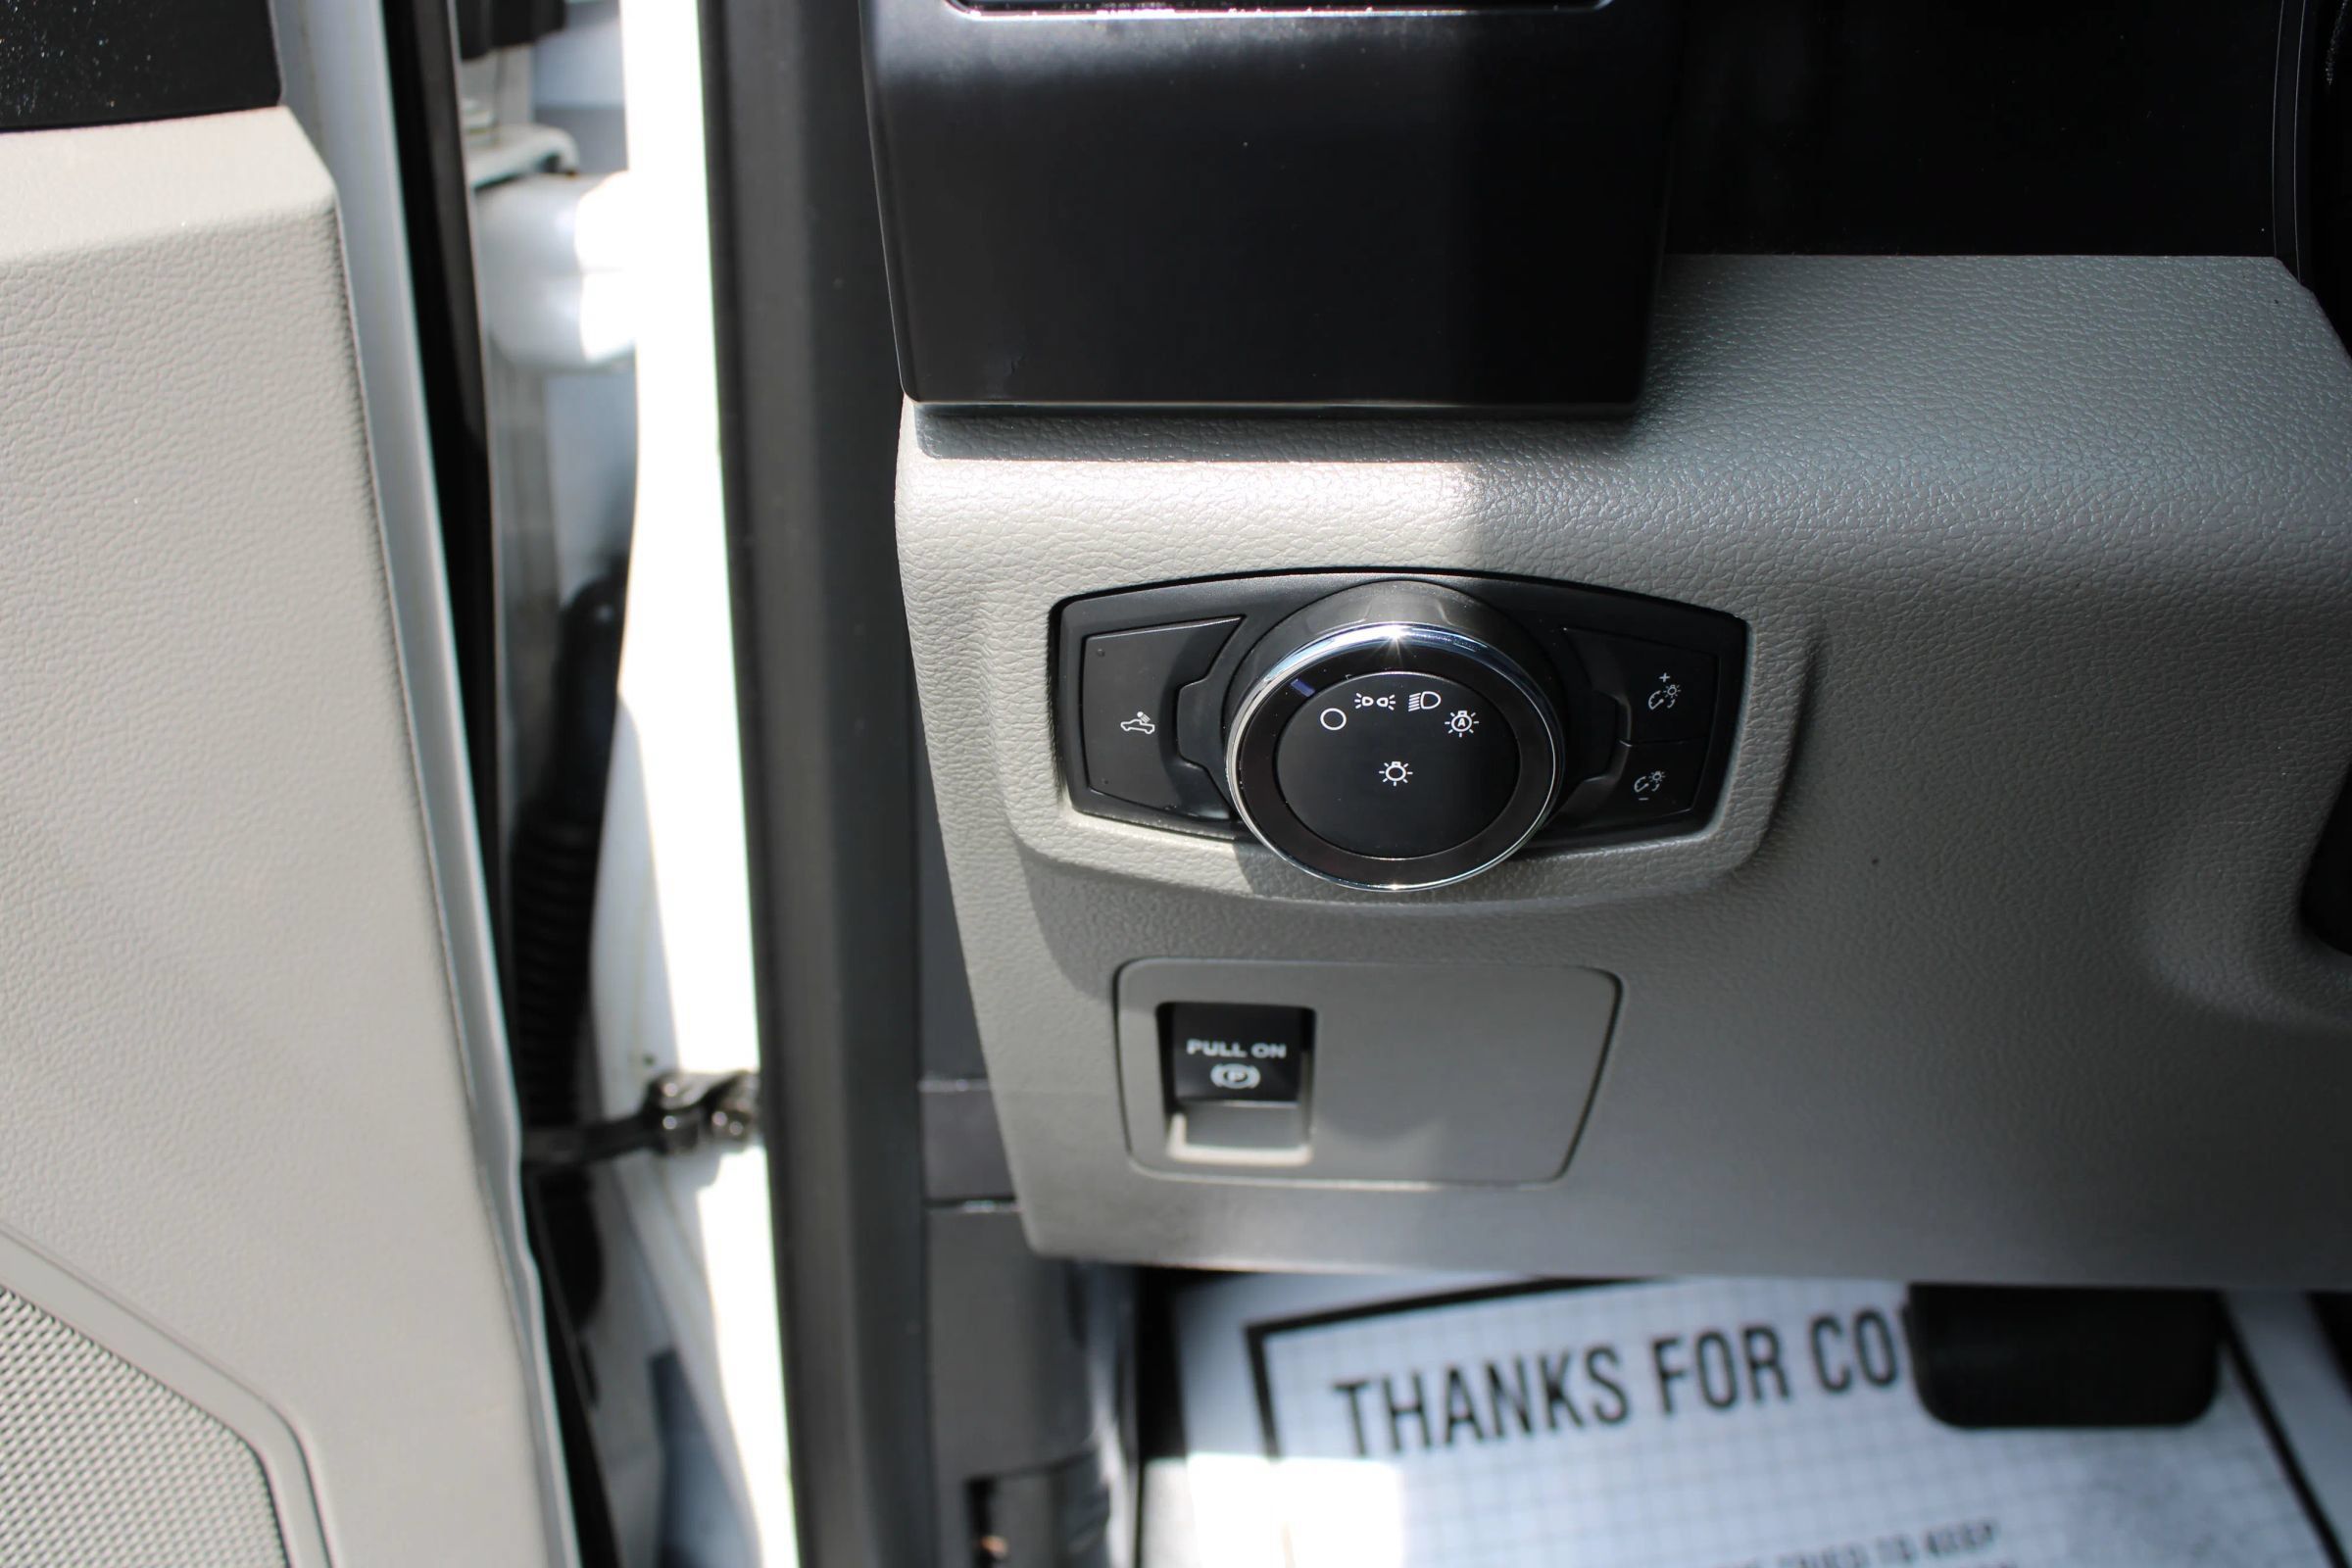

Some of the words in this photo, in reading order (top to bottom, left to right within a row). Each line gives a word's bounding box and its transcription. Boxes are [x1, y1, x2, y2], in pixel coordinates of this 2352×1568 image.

[1186, 1039, 1247, 1058] PULL
[1250, 1043, 1287, 1059] ON
[1331, 1344, 1630, 1456] THANKS
[1649, 1323, 1789, 1416] FOR
[1808, 1306, 1909, 1394] CO
